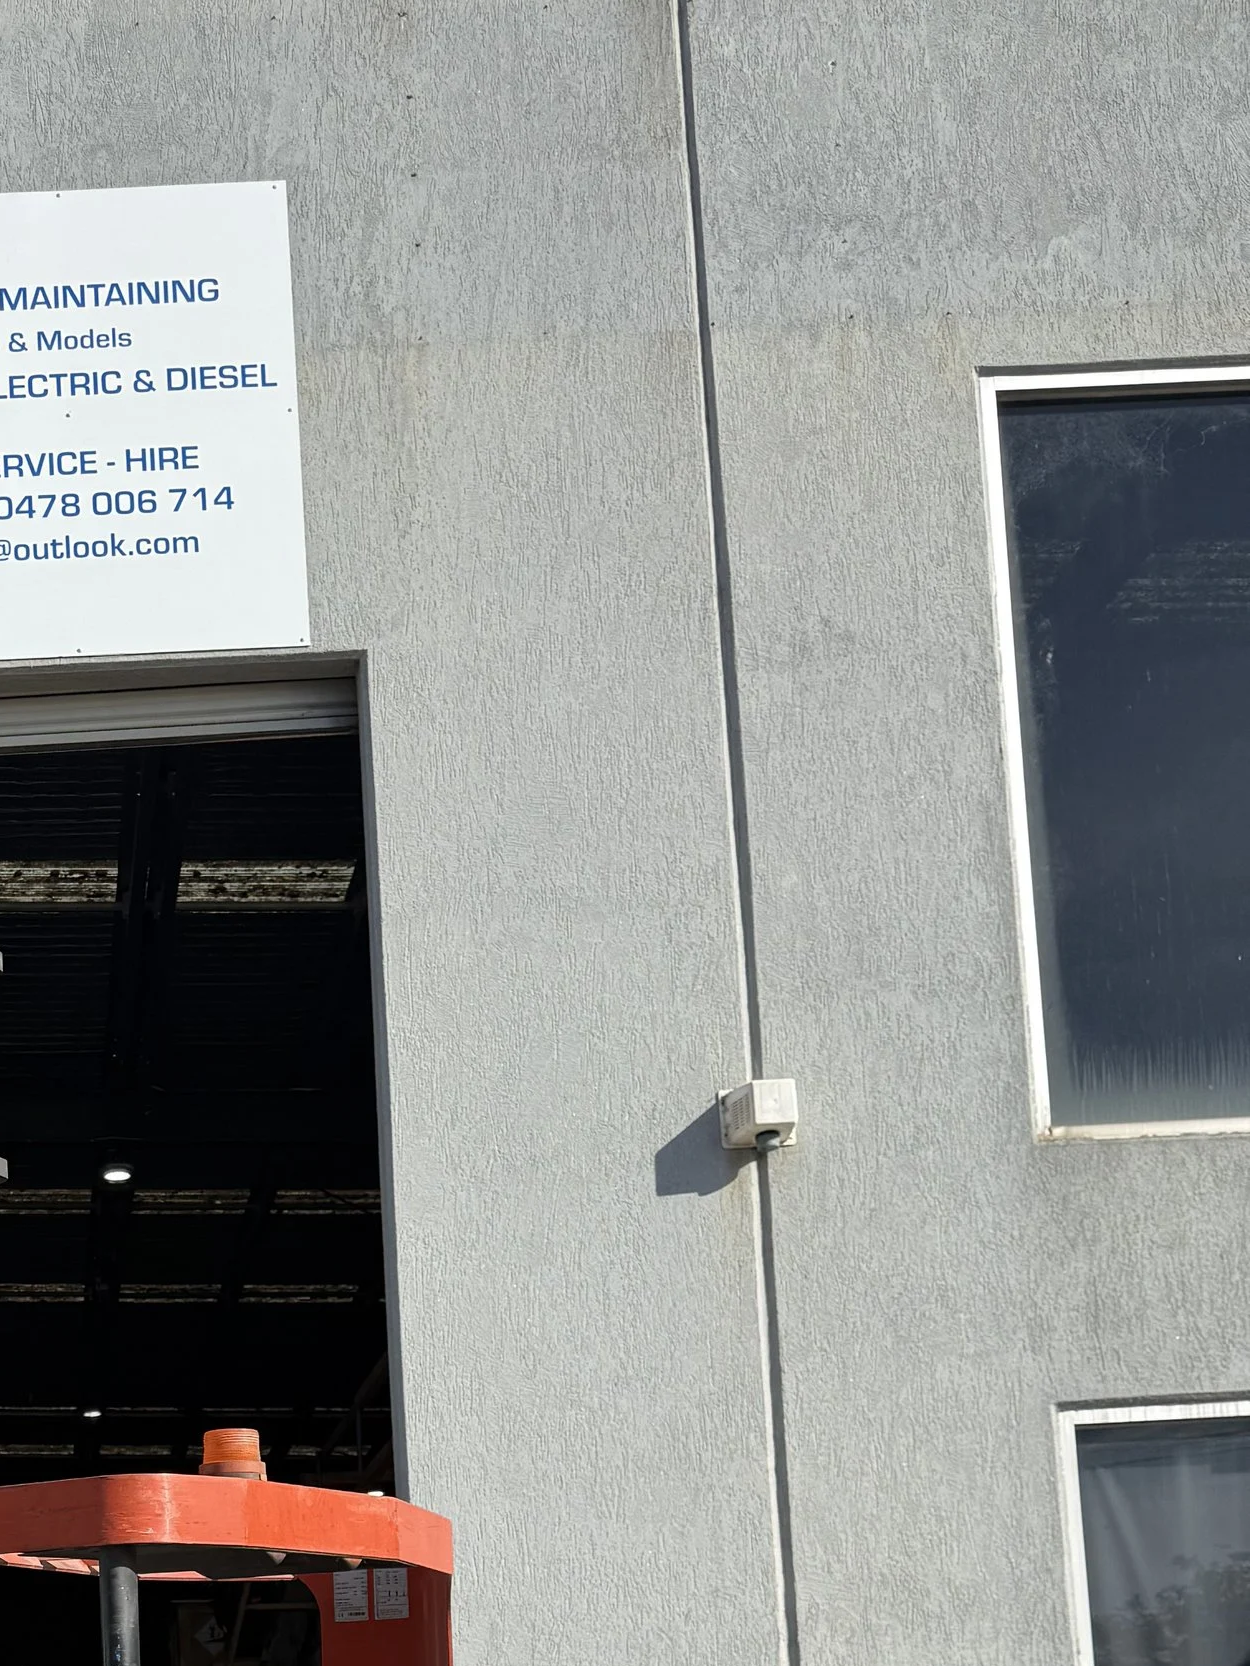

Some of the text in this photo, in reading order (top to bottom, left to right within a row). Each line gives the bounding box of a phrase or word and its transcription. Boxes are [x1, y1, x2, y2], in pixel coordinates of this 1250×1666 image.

[8, 332, 28, 353] &
[37, 327, 132, 351] Models
[133, 369, 156, 393] &
[166, 363, 278, 392] DIESEL
[125, 446, 199, 472] HIRE
[91, 489, 157, 516] 006
[168, 486, 234, 512] 714
